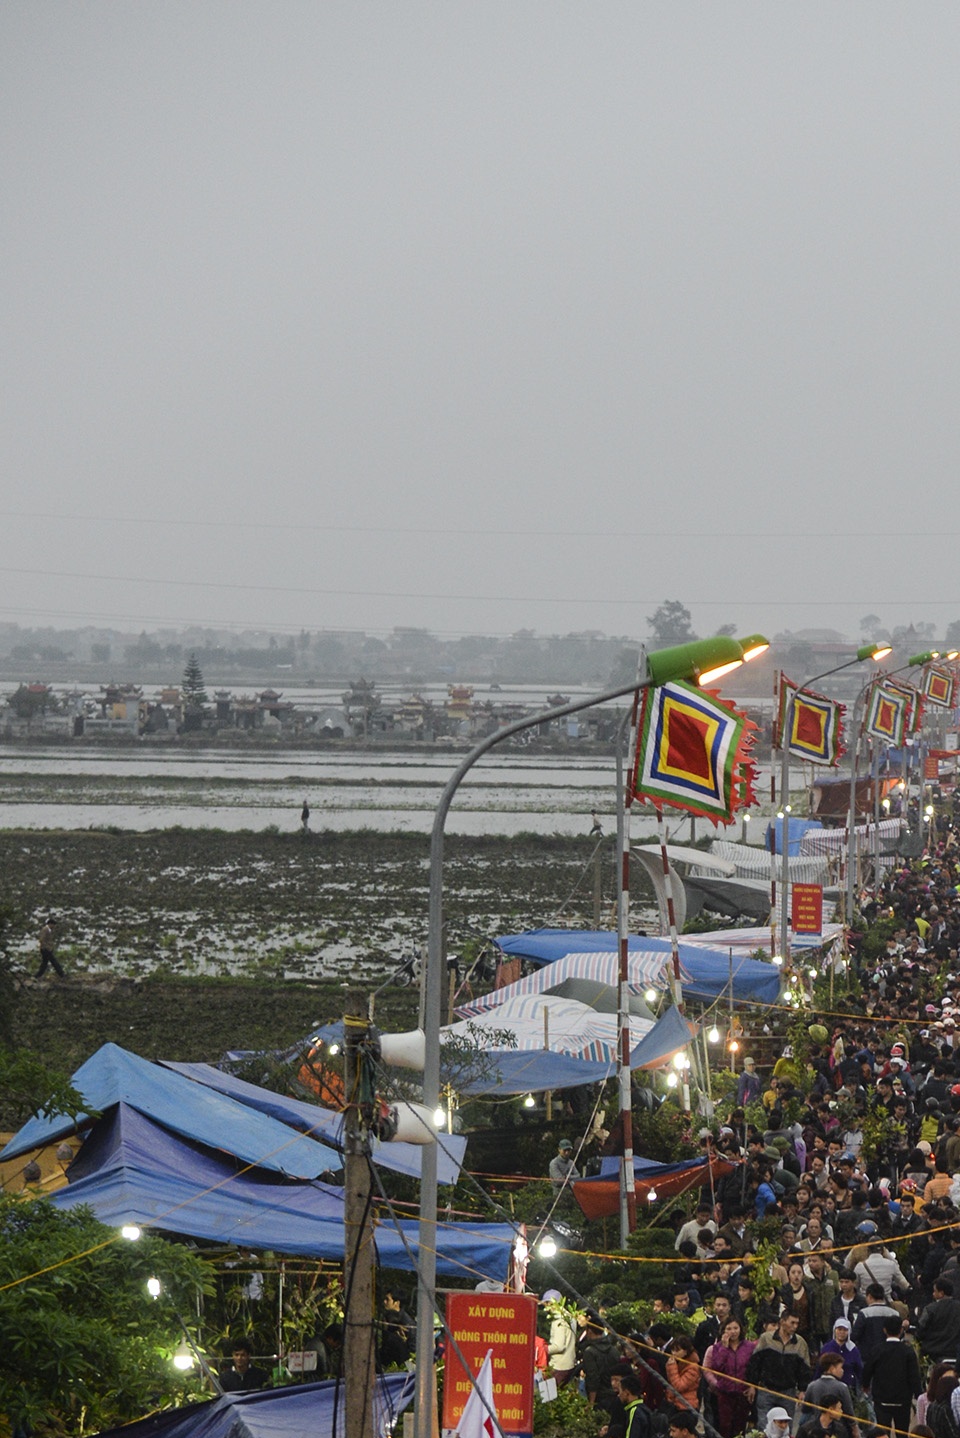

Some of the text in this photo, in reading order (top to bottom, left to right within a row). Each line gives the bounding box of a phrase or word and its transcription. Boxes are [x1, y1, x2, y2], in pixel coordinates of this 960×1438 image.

[468, 1305, 515, 1320] XÂY DỰNG
[453, 1330, 528, 1345] NÔNG THÔN MỚI
[494, 1357, 507, 1369] RA
[504, 1383, 523, 1395] MỚI
[502, 1407, 524, 1420] MỚI!
